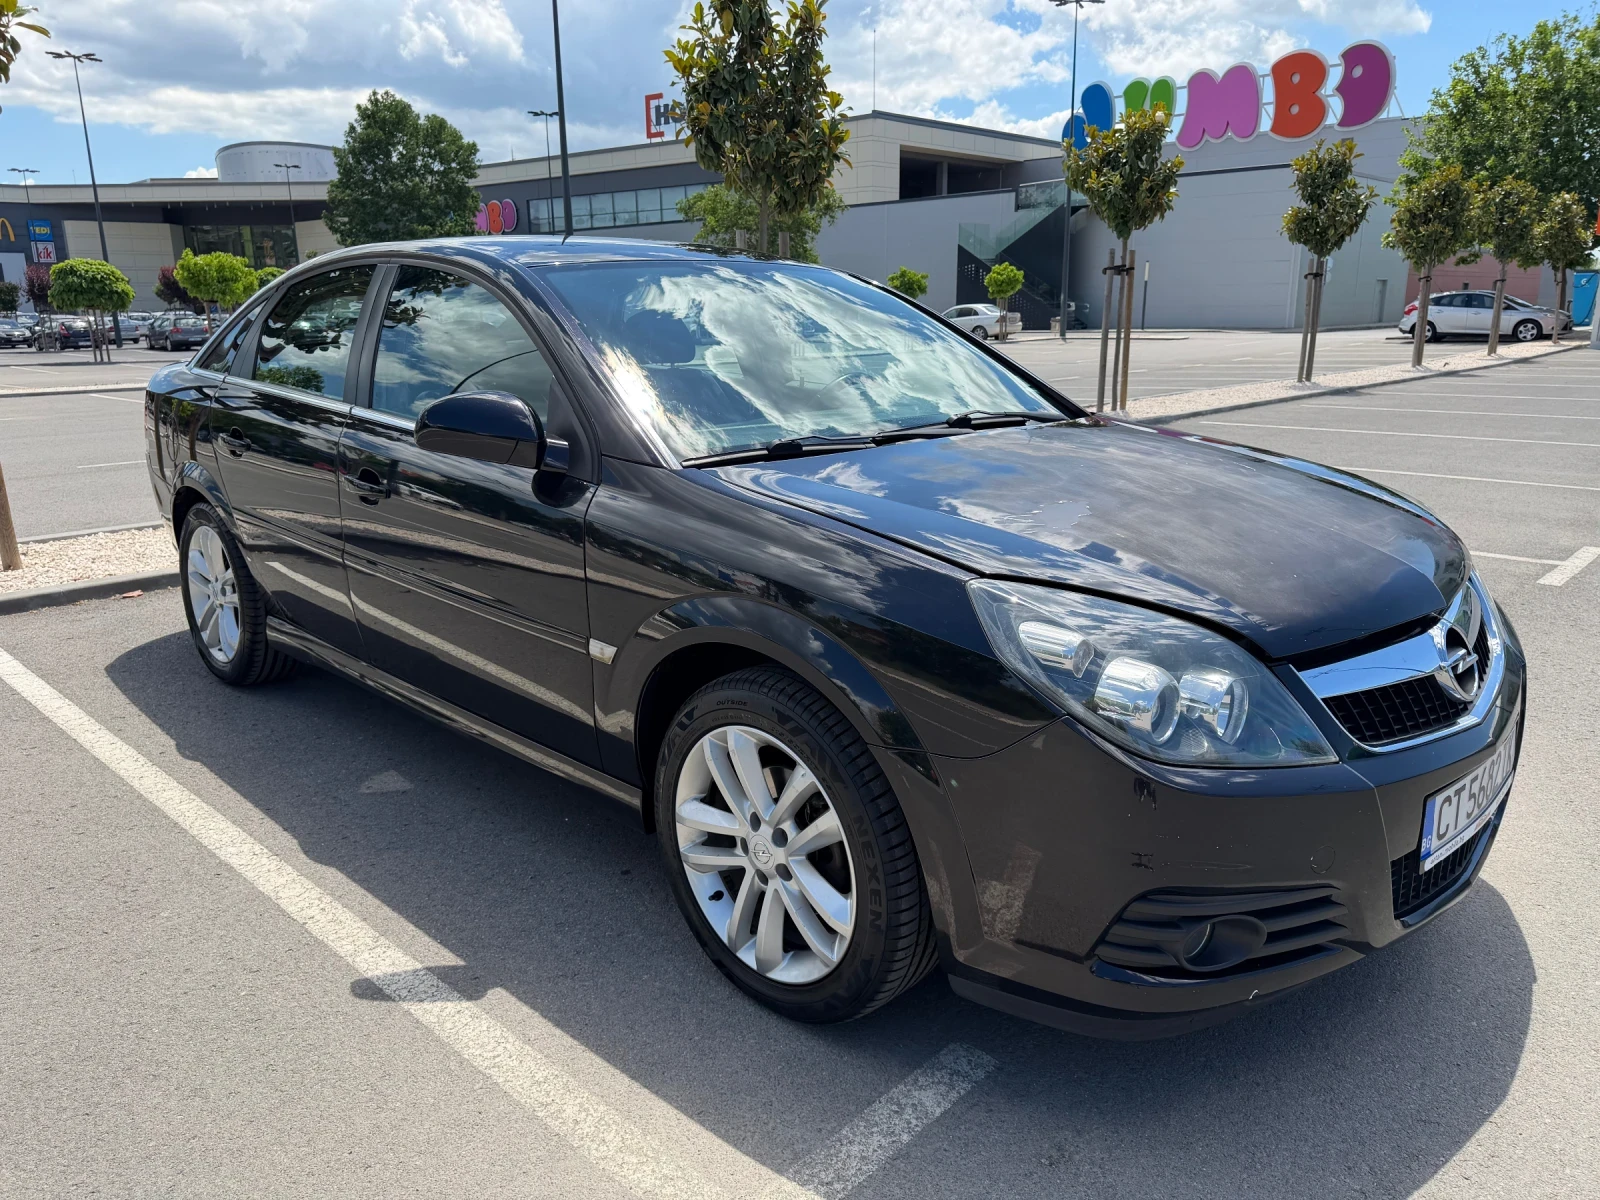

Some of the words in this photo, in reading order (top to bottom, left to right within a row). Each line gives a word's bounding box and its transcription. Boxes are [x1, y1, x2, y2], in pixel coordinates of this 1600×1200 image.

[716, 699, 749, 707] OUTSIDE
[1422, 836, 1432, 851] BG
[854, 815, 883, 935] NEXEN
